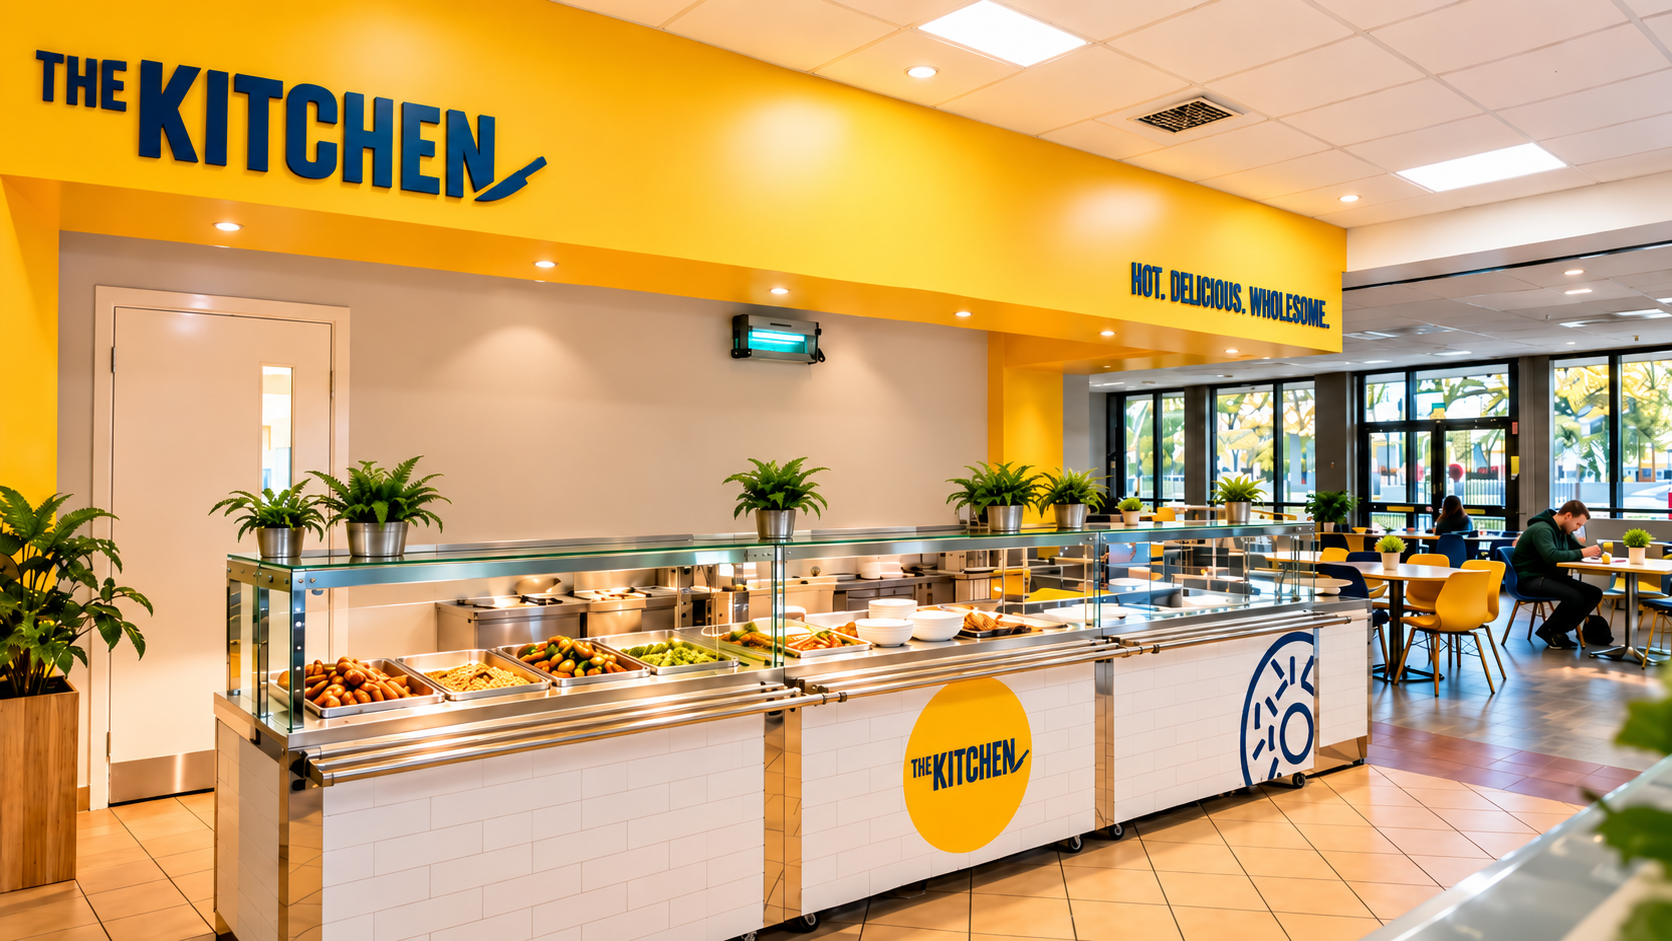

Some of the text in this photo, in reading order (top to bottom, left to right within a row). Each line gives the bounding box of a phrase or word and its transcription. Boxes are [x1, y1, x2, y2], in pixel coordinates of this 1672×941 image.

[36, 49, 496, 199] THE KITCHEN
[1131, 262, 1330, 329] HOT. DELICIOUS. WHOLESOME.
[911, 738, 1015, 791] THE KITCHEN
